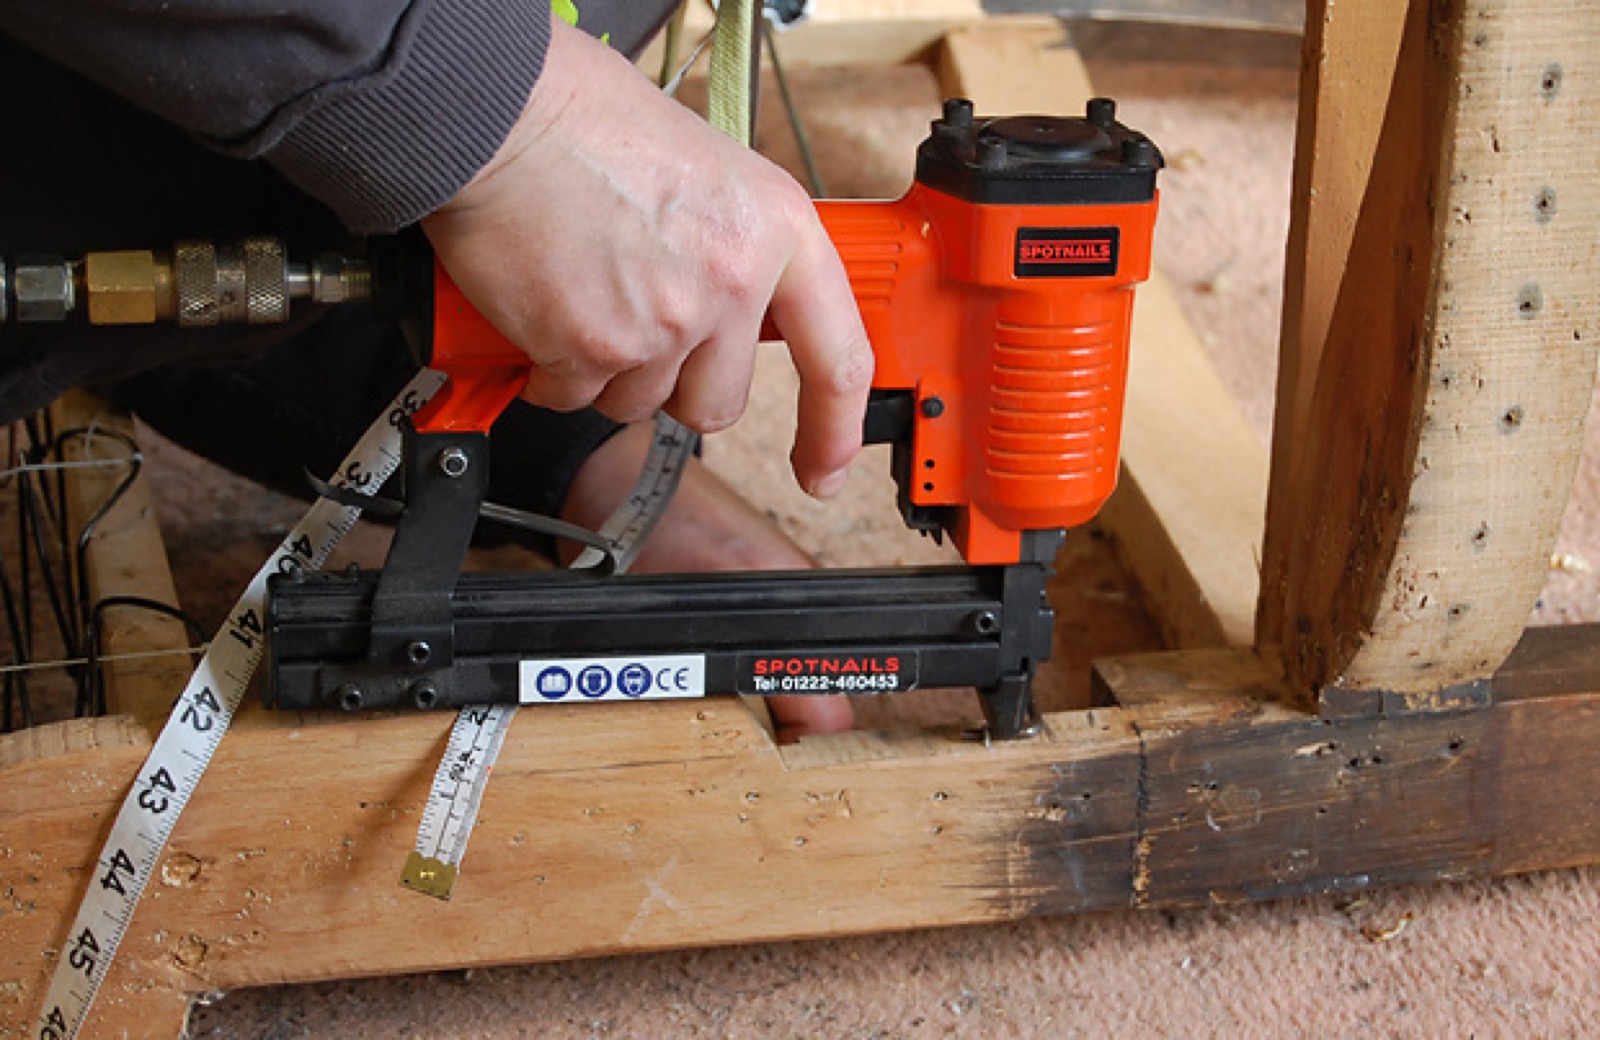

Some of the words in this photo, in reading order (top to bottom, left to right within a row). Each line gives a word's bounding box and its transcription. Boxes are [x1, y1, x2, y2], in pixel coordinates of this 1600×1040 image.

[1020, 243, 1111, 260] SPOTNAILS
[230, 608, 263, 649] 41
[753, 655, 900, 676] SPOTNAILS
[180, 686, 221, 732] 42
[138, 766, 176, 814] 43
[100, 848, 136, 896] 44
[69, 927, 101, 977] 45
